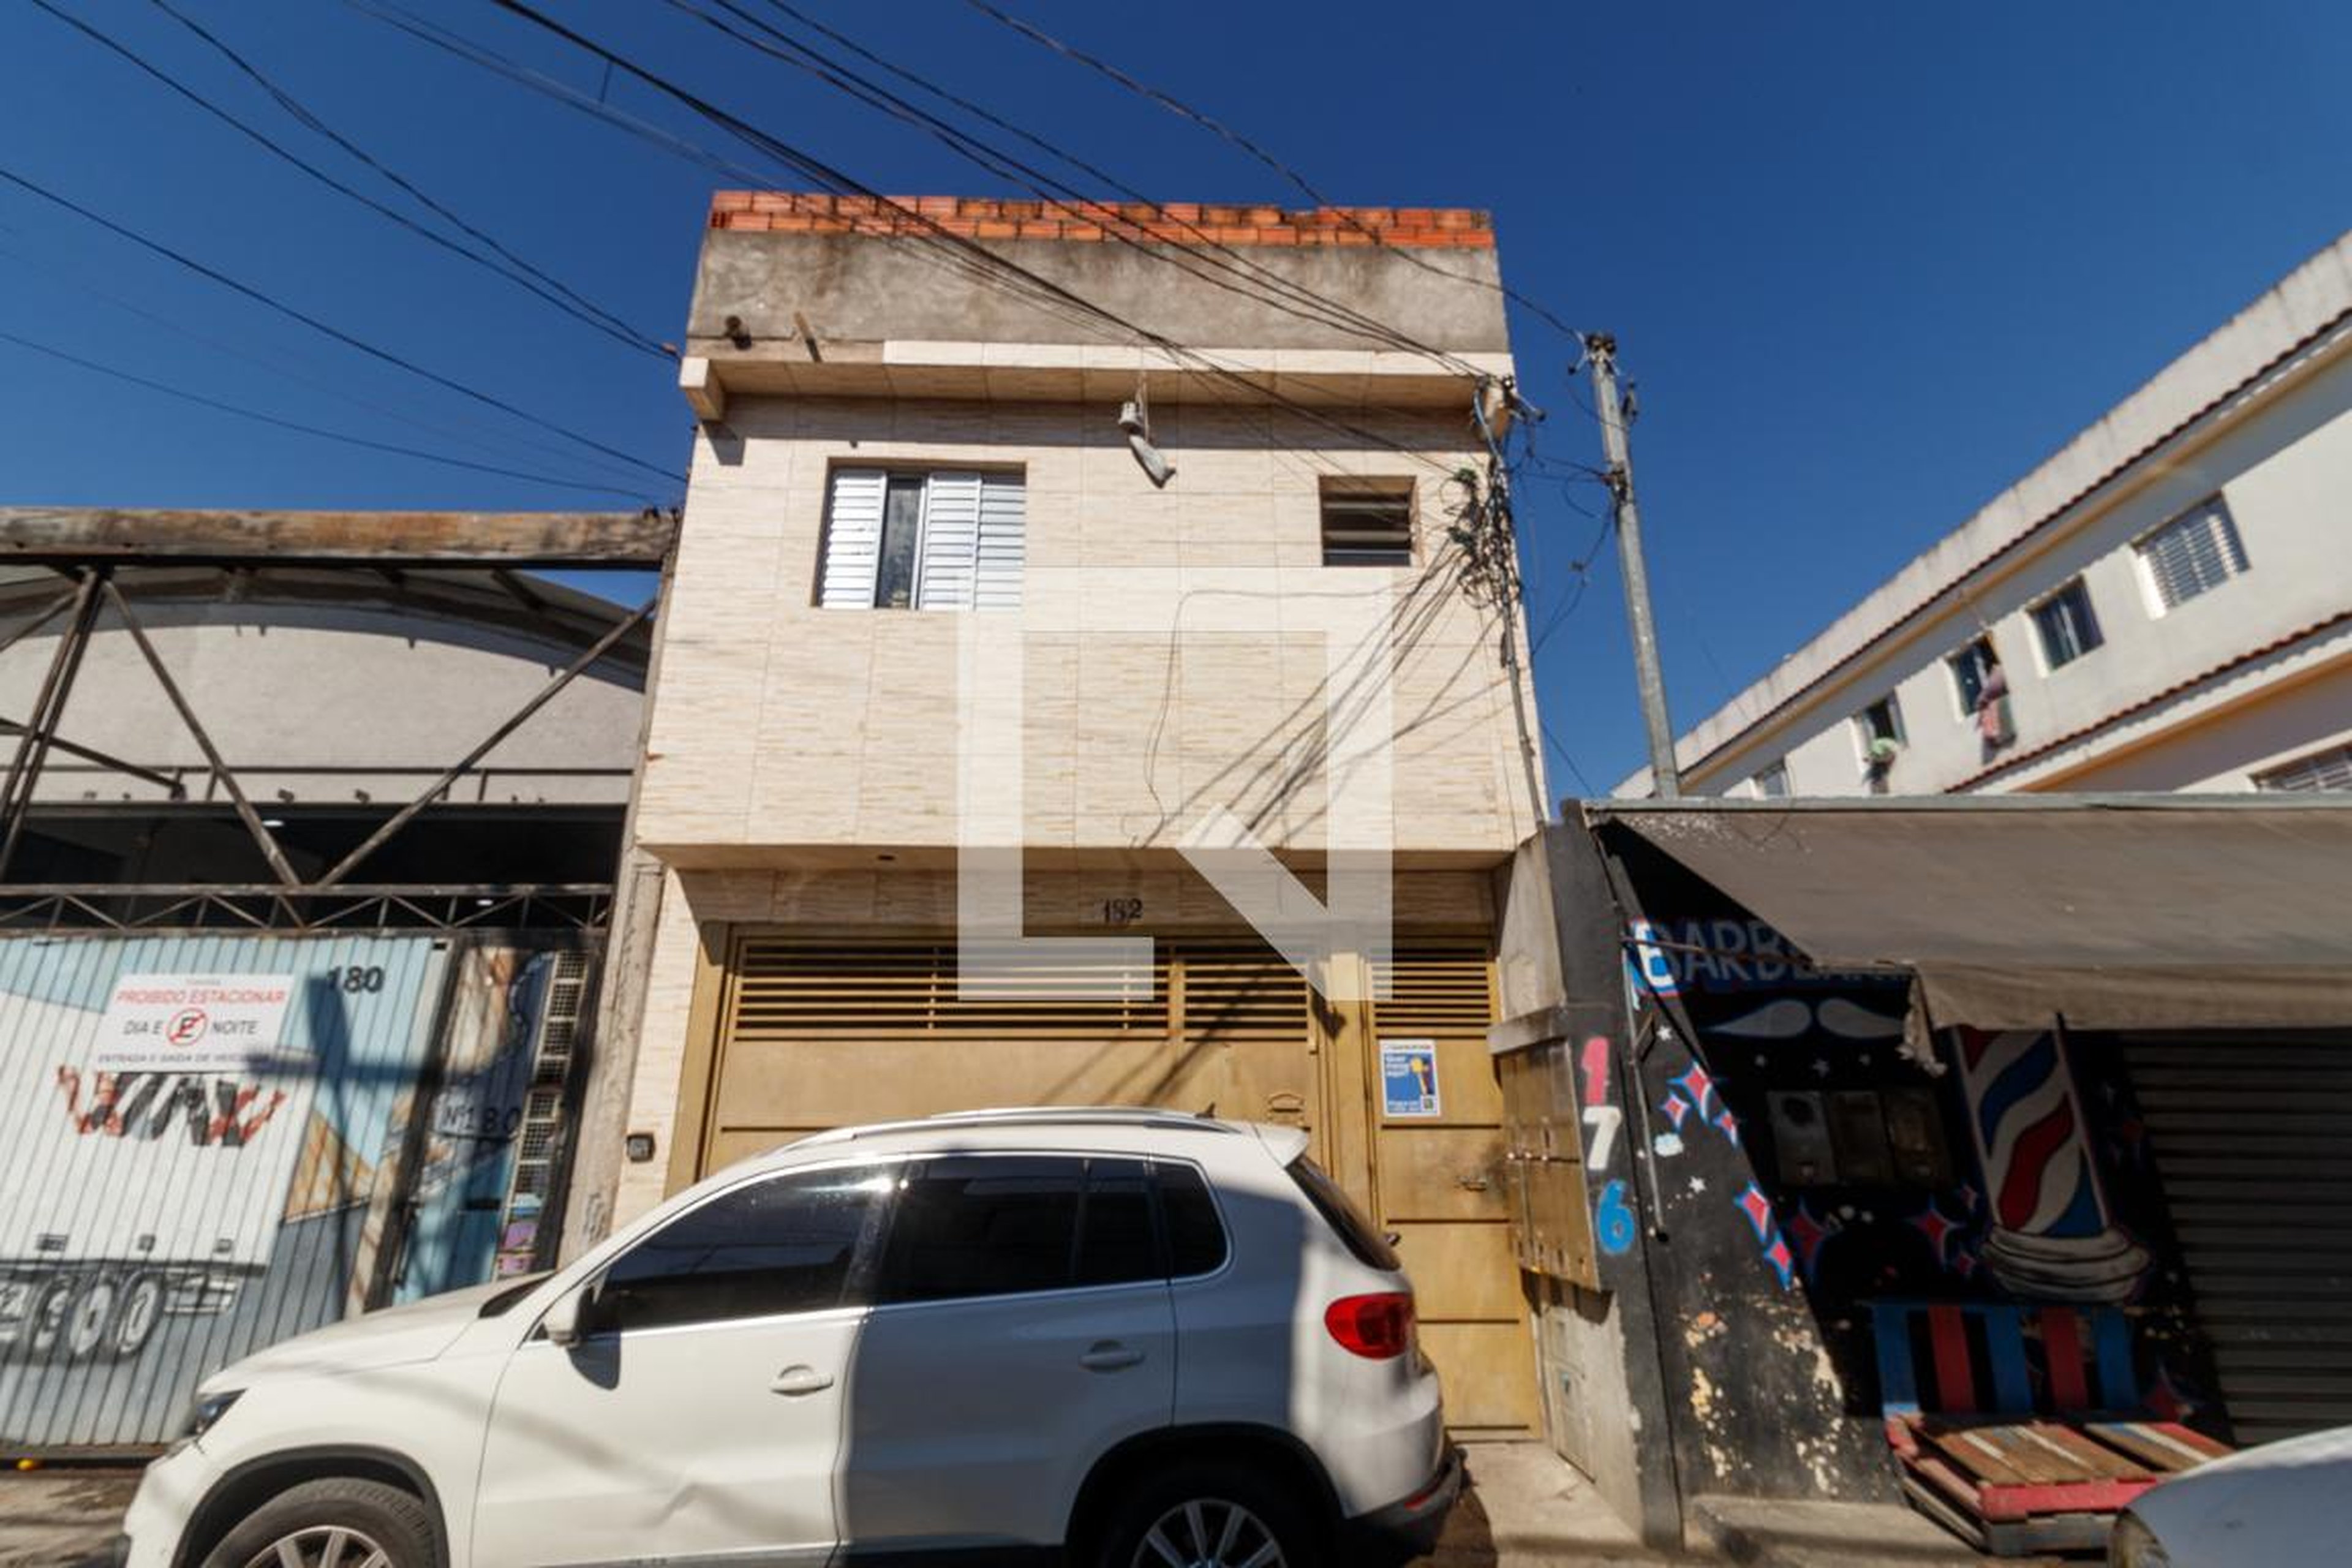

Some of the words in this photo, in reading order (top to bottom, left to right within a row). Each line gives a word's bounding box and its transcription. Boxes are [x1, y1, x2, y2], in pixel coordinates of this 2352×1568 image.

[1104, 898, 1143, 923] 182
[327, 966, 385, 993] 180
[116, 990, 186, 1005] PROIBIDO
[188, 990, 285, 1005] ESTACIONAR
[123, 1020, 148, 1035] DIA
[152, 1020, 163, 1035] E
[212, 1020, 260, 1035] NOITE
